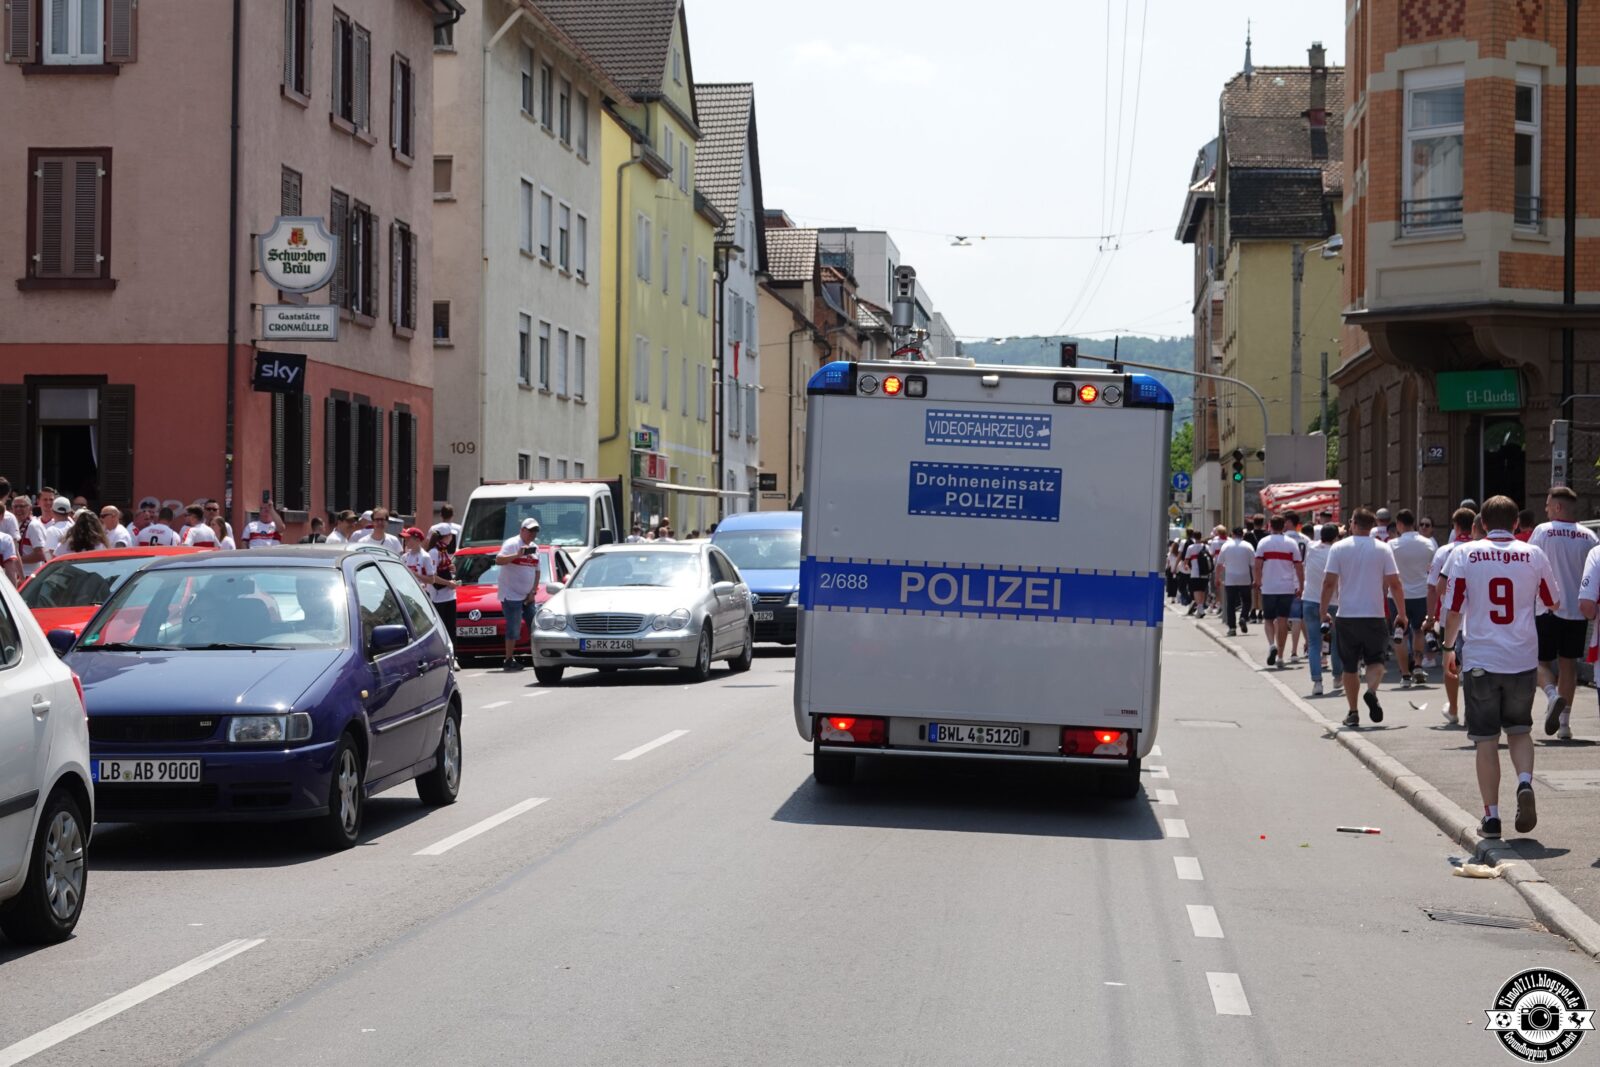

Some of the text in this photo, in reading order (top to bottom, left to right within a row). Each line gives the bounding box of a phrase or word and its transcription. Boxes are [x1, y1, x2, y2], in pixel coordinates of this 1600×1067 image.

[267, 249, 327, 262] Schwaben
[282, 262, 311, 275] Bräu
[278, 312, 321, 321] Gaststätte
[268, 322, 329, 332] CRONMÜLLER
[261, 360, 299, 384] sky
[1466, 388, 1516, 403] El-Quds
[928, 420, 1034, 438] VIDEOFAHRZEUG
[450, 441, 476, 454] 109
[916, 472, 1055, 492] Drohneneinsatz
[945, 492, 1024, 510] POLIZEI
[1547, 529, 1589, 540] Stuttgart
[1469, 551, 1531, 564] Stuttgart
[820, 573, 868, 590] 2/688
[900, 571, 1062, 610] POLIZEI
[1489, 577, 1514, 625] 9
[586, 640, 632, 649] S RK 2148
[938, 726, 964, 742] BWL
[967, 727, 976, 742] 4
[986, 728, 1020, 744] 5120
[100, 762, 121, 780] LB
[134, 762, 154, 780] AB
[158, 762, 199, 780] 9000
